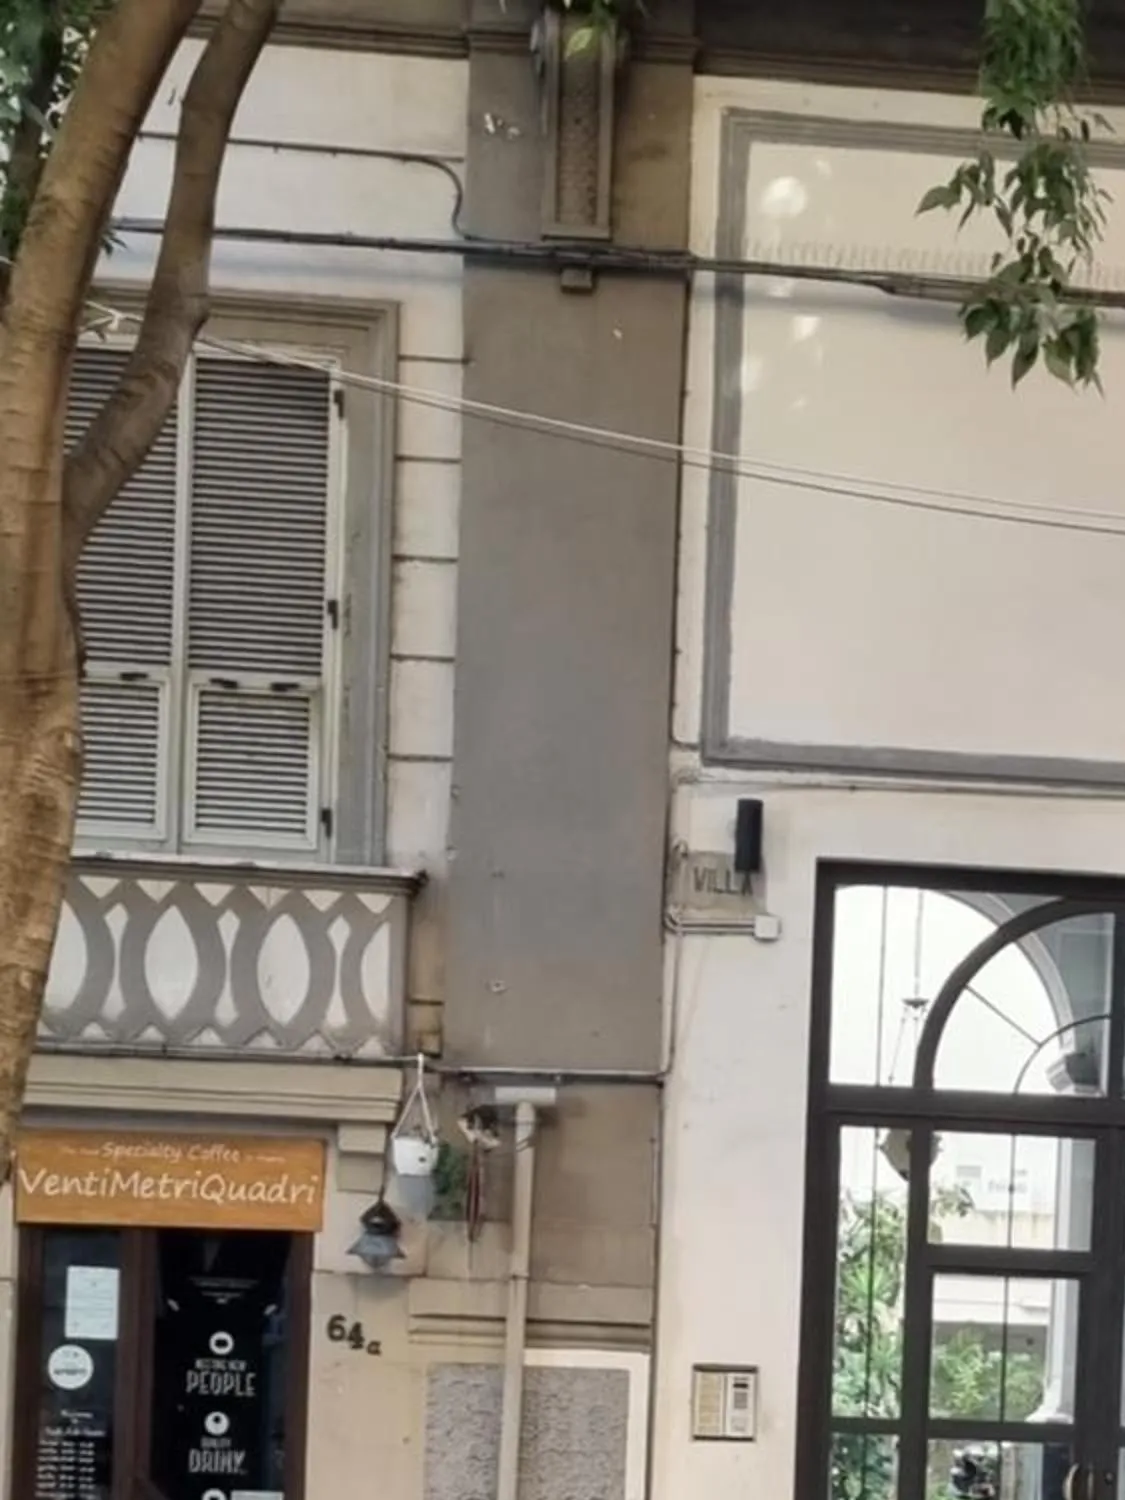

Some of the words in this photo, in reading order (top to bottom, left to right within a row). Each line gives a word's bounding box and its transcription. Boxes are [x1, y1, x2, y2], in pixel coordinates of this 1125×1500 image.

[693, 866, 755, 897] VILLA
[101, 1140, 182, 1164] Specialty
[187, 1143, 241, 1163] Coffee
[17, 1166, 319, 1206] VentiMetriQuadri
[185, 1369, 256, 1397] PEOPLE
